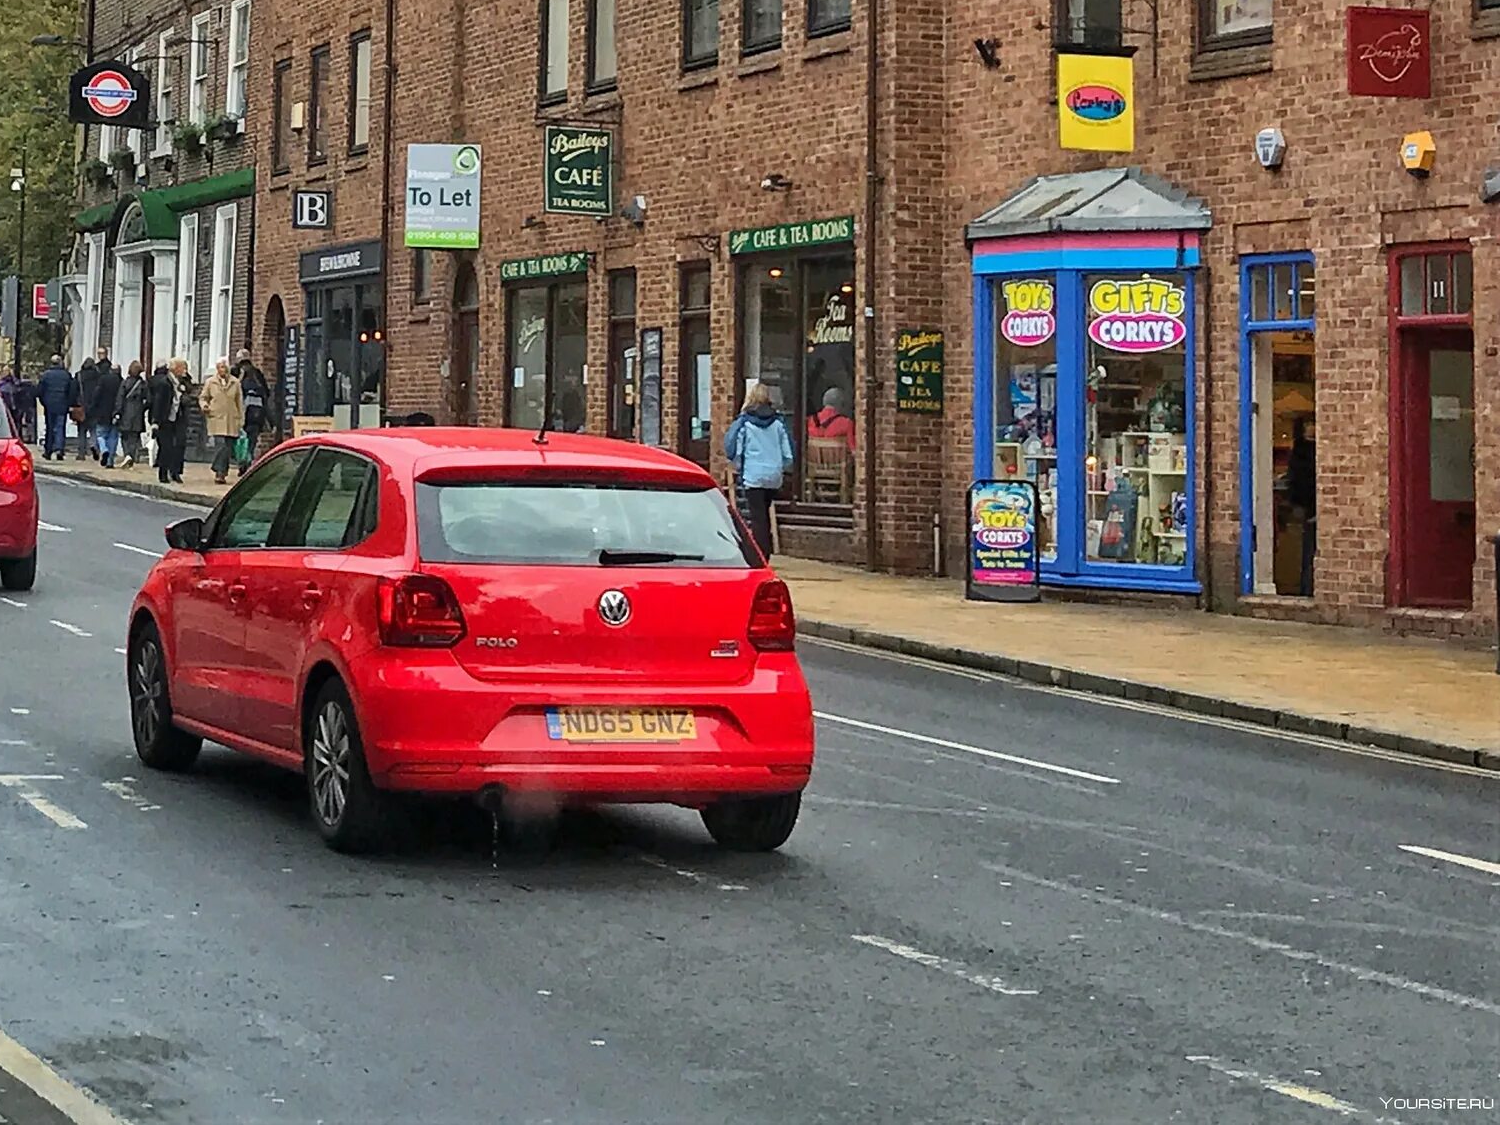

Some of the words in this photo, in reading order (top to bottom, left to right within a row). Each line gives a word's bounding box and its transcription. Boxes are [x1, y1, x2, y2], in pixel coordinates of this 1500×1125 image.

[554, 165, 603, 186] CAFÉ
[408, 187, 432, 206] To
[439, 187, 472, 206] Let
[552, 197, 569, 207] TEA
[571, 199, 607, 209] ROOMS
[301, 195, 325, 223] B
[753, 229, 777, 248] CAFE
[779, 228, 788, 245] &
[790, 226, 809, 244] TEA
[812, 219, 849, 241] ROOMS
[826, 295, 847, 322] Tea
[813, 317, 853, 344] Rooms
[1007, 316, 1049, 338] CORKYS
[1100, 320, 1175, 343] CORKYS
[908, 387, 932, 396] TEA
[900, 399, 941, 409] ROOMS
[982, 530, 1024, 544] CORKYS
[475, 636, 518, 647] POLO
[565, 710, 632, 734] ND65
[640, 712, 692, 735] GNZ
